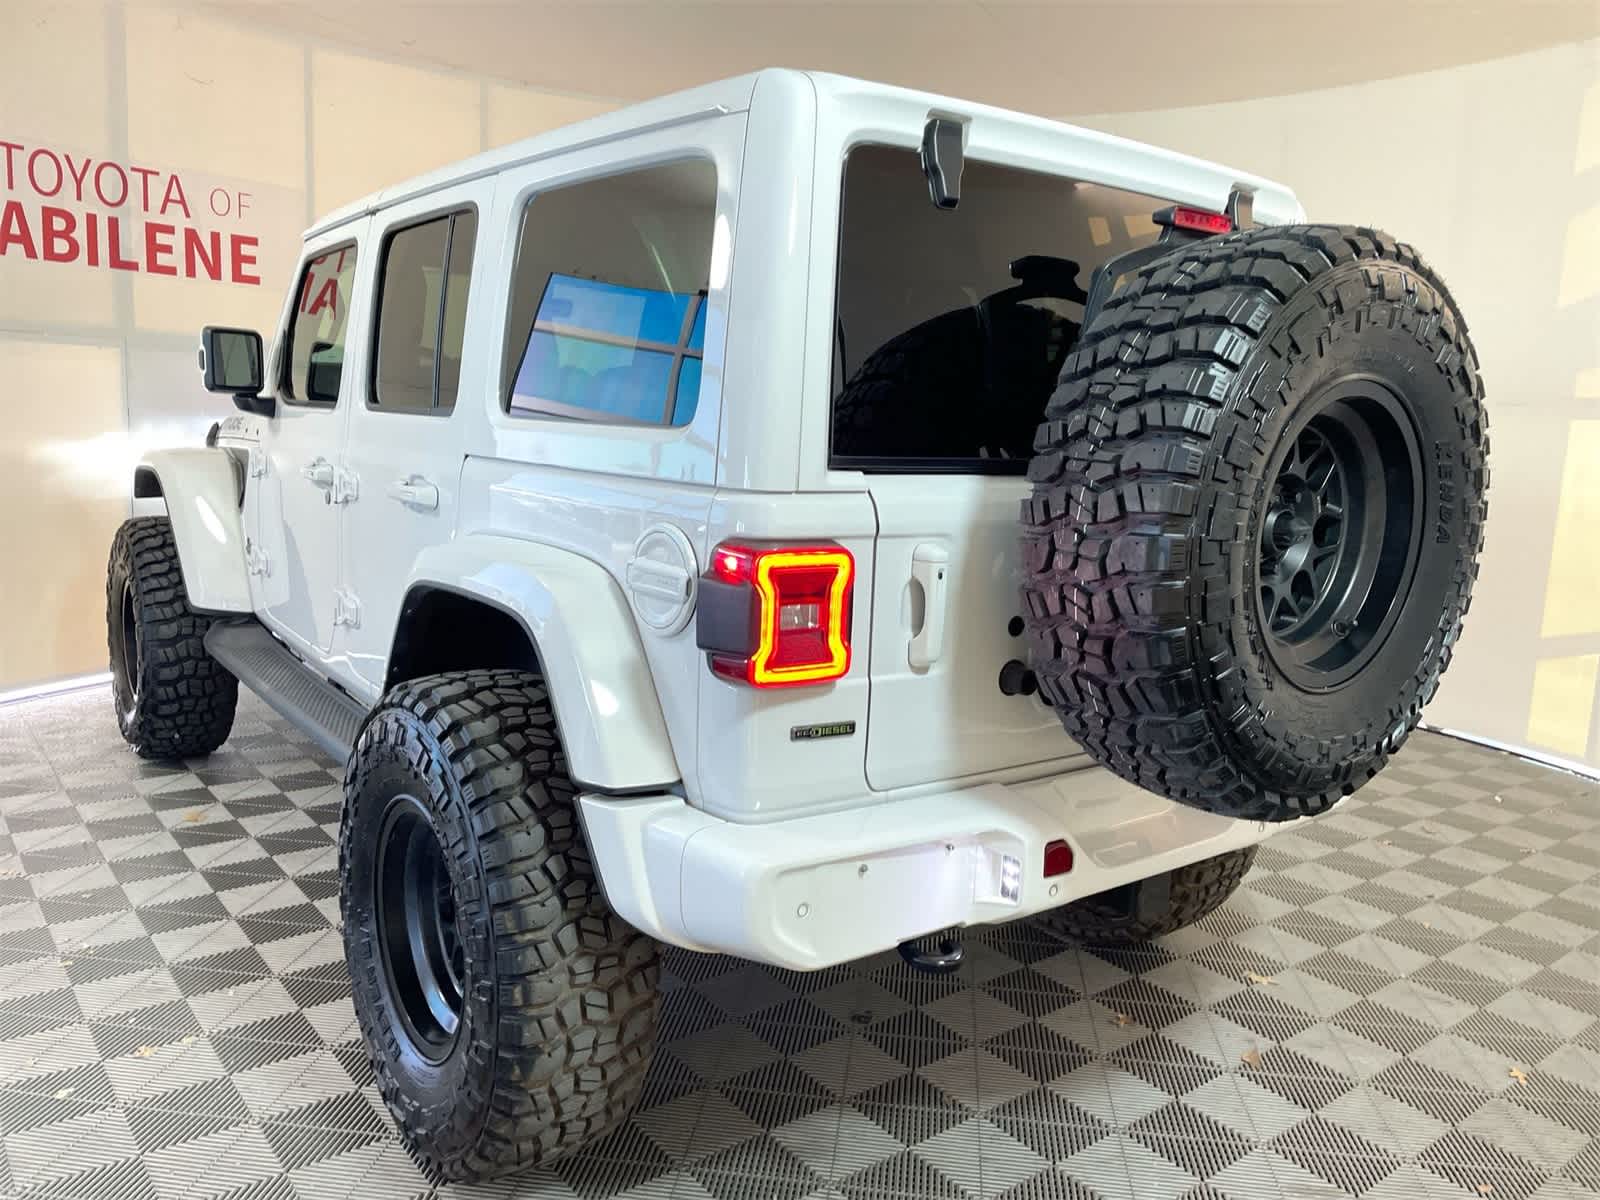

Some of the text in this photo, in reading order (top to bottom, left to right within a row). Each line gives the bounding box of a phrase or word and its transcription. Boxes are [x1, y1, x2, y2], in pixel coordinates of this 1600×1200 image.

[0, 140, 252, 219] TOYOTA OF
[0, 200, 261, 286] ABILENE
